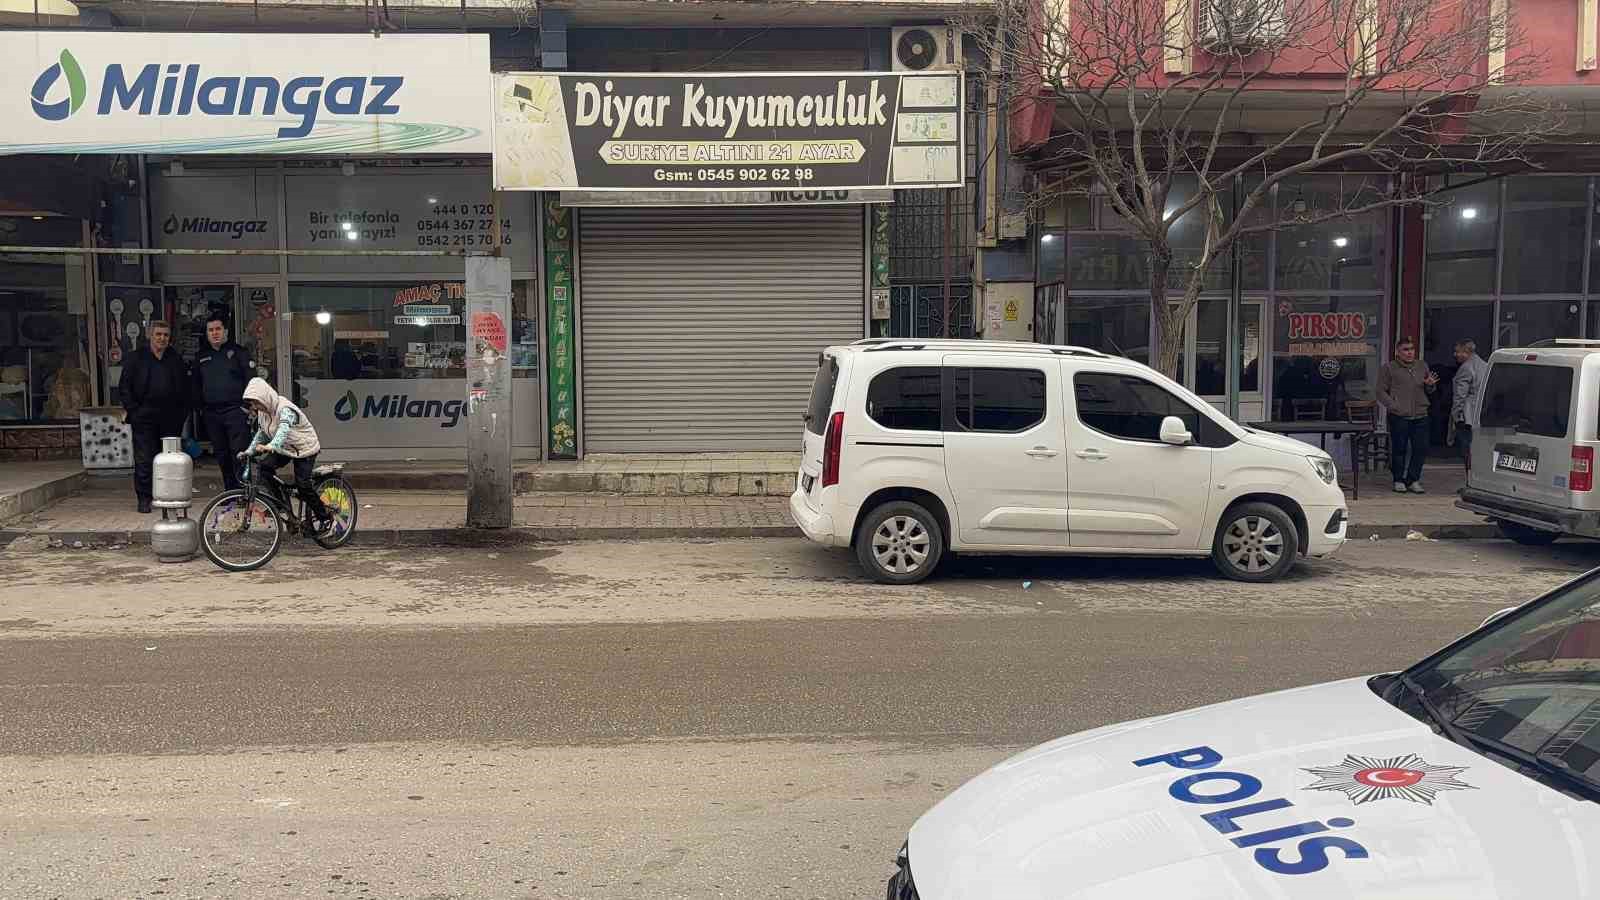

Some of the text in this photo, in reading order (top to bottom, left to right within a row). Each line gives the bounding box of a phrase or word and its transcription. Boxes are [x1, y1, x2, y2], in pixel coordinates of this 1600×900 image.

[97, 63, 404, 138] Milangaz
[575, 81, 670, 138] Diyar
[682, 79, 888, 138] Kuyumculuk
[695, 143, 763, 160] ALTINI
[768, 144, 793, 160] 21
[799, 143, 855, 160] AYAR
[653, 167, 814, 182] Gsm: 0545 902 62 98
[433, 203, 494, 216] 444 0 120
[310, 211, 400, 225] Bir telefonla
[417, 220, 449, 231] 0544
[453, 219, 474, 231] 367
[479, 219, 495, 230] 27
[181, 217, 268, 239] Milangaz
[418, 235, 449, 246] 0542
[453, 235, 474, 245] 215
[478, 234, 493, 245] 70
